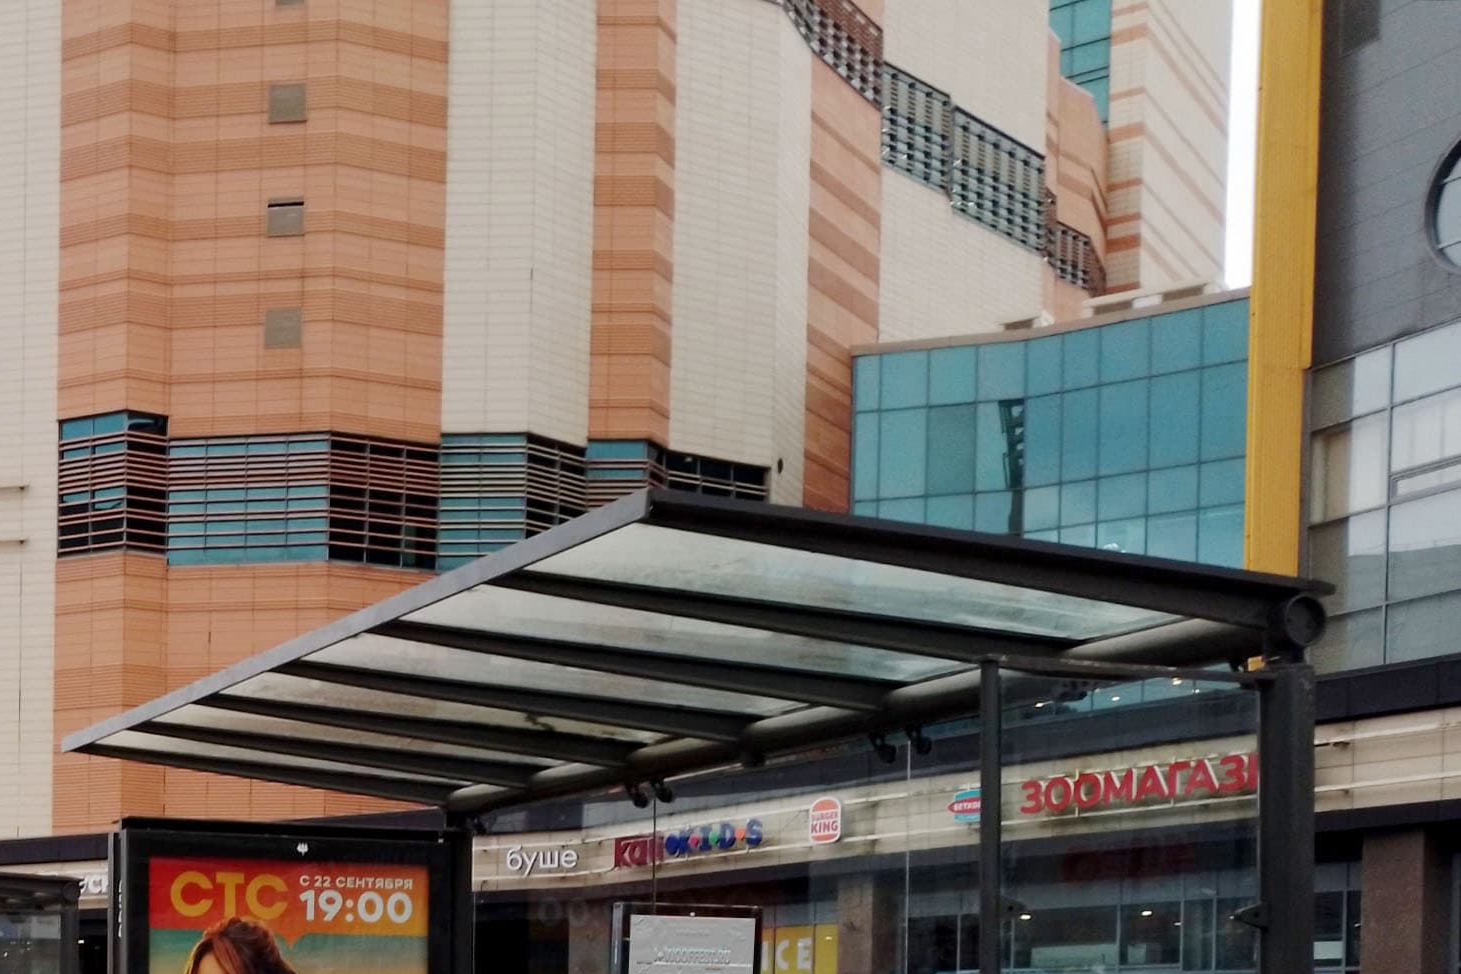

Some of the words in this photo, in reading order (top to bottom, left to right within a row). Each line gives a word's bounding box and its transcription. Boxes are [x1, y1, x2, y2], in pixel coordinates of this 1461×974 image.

[811, 820, 838, 834] KING
[506, 845, 578, 877] буше
[170, 870, 289, 919] СТС
[299, 876, 310, 888] С
[314, 876, 333, 888] 22
[335, 877, 413, 891] СЕНТЯБРЯ
[299, 890, 413, 924] 19:00
